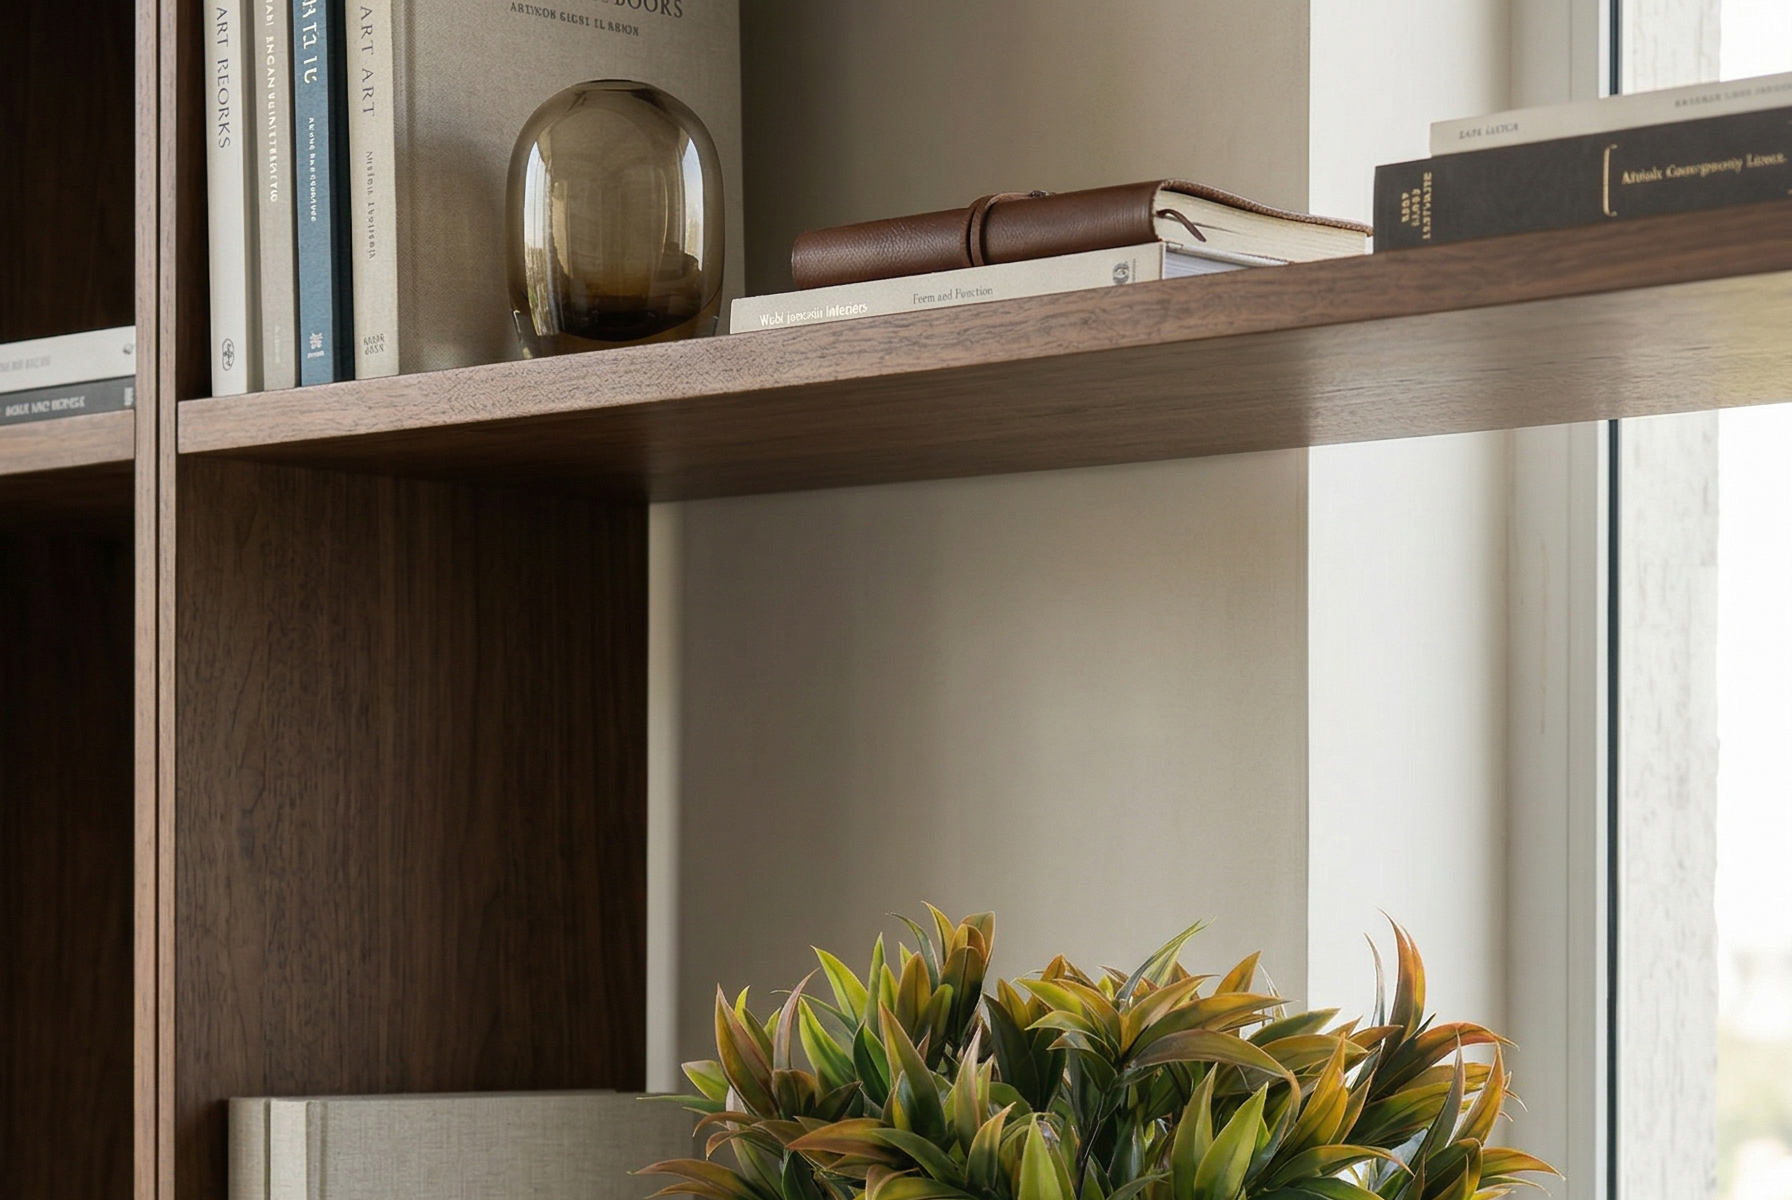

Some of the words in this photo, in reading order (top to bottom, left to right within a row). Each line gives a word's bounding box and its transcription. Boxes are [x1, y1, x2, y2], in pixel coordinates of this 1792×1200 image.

[216, 6, 230, 48] ART
[359, 5, 375, 56] ART
[361, 66, 376, 117] ART
